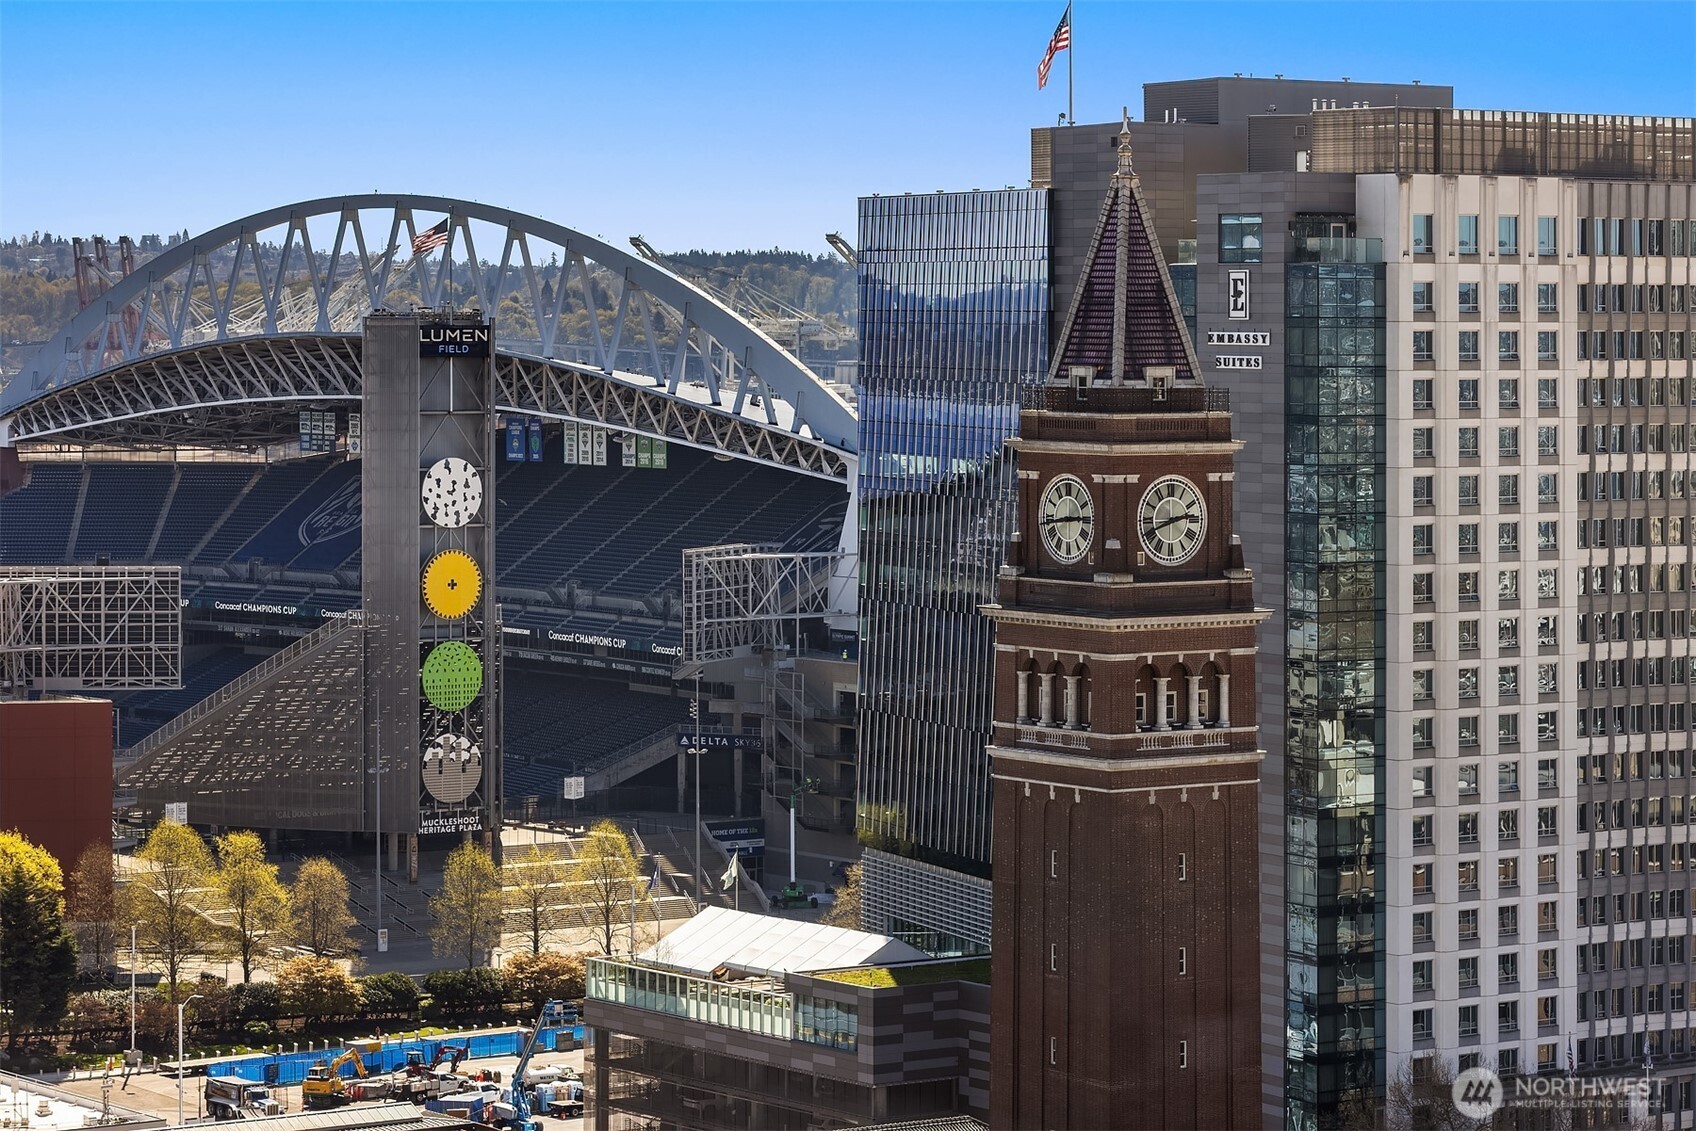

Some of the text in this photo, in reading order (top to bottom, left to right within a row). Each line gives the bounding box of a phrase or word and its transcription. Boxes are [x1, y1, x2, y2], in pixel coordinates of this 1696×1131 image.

[419, 329, 488, 342] LUMEN
[1208, 333, 1268, 344] EMBASSY
[438, 344, 470, 353] FIELD
[1215, 357, 1260, 368] SUITES
[180, 599, 190, 607] UP
[214, 601, 297, 615] Concacaf CHAMPIONS CUP
[320, 608, 347, 619] Concacaf
[548, 630, 627, 649] Concacaf CHAMPIONS CUP
[651, 643, 676, 656] Concacaf
[692, 736, 728, 746] DELTA
[422, 816, 480, 827] MUCKLESHOOT
[418, 824, 483, 835] HERITAGE PLAZA
